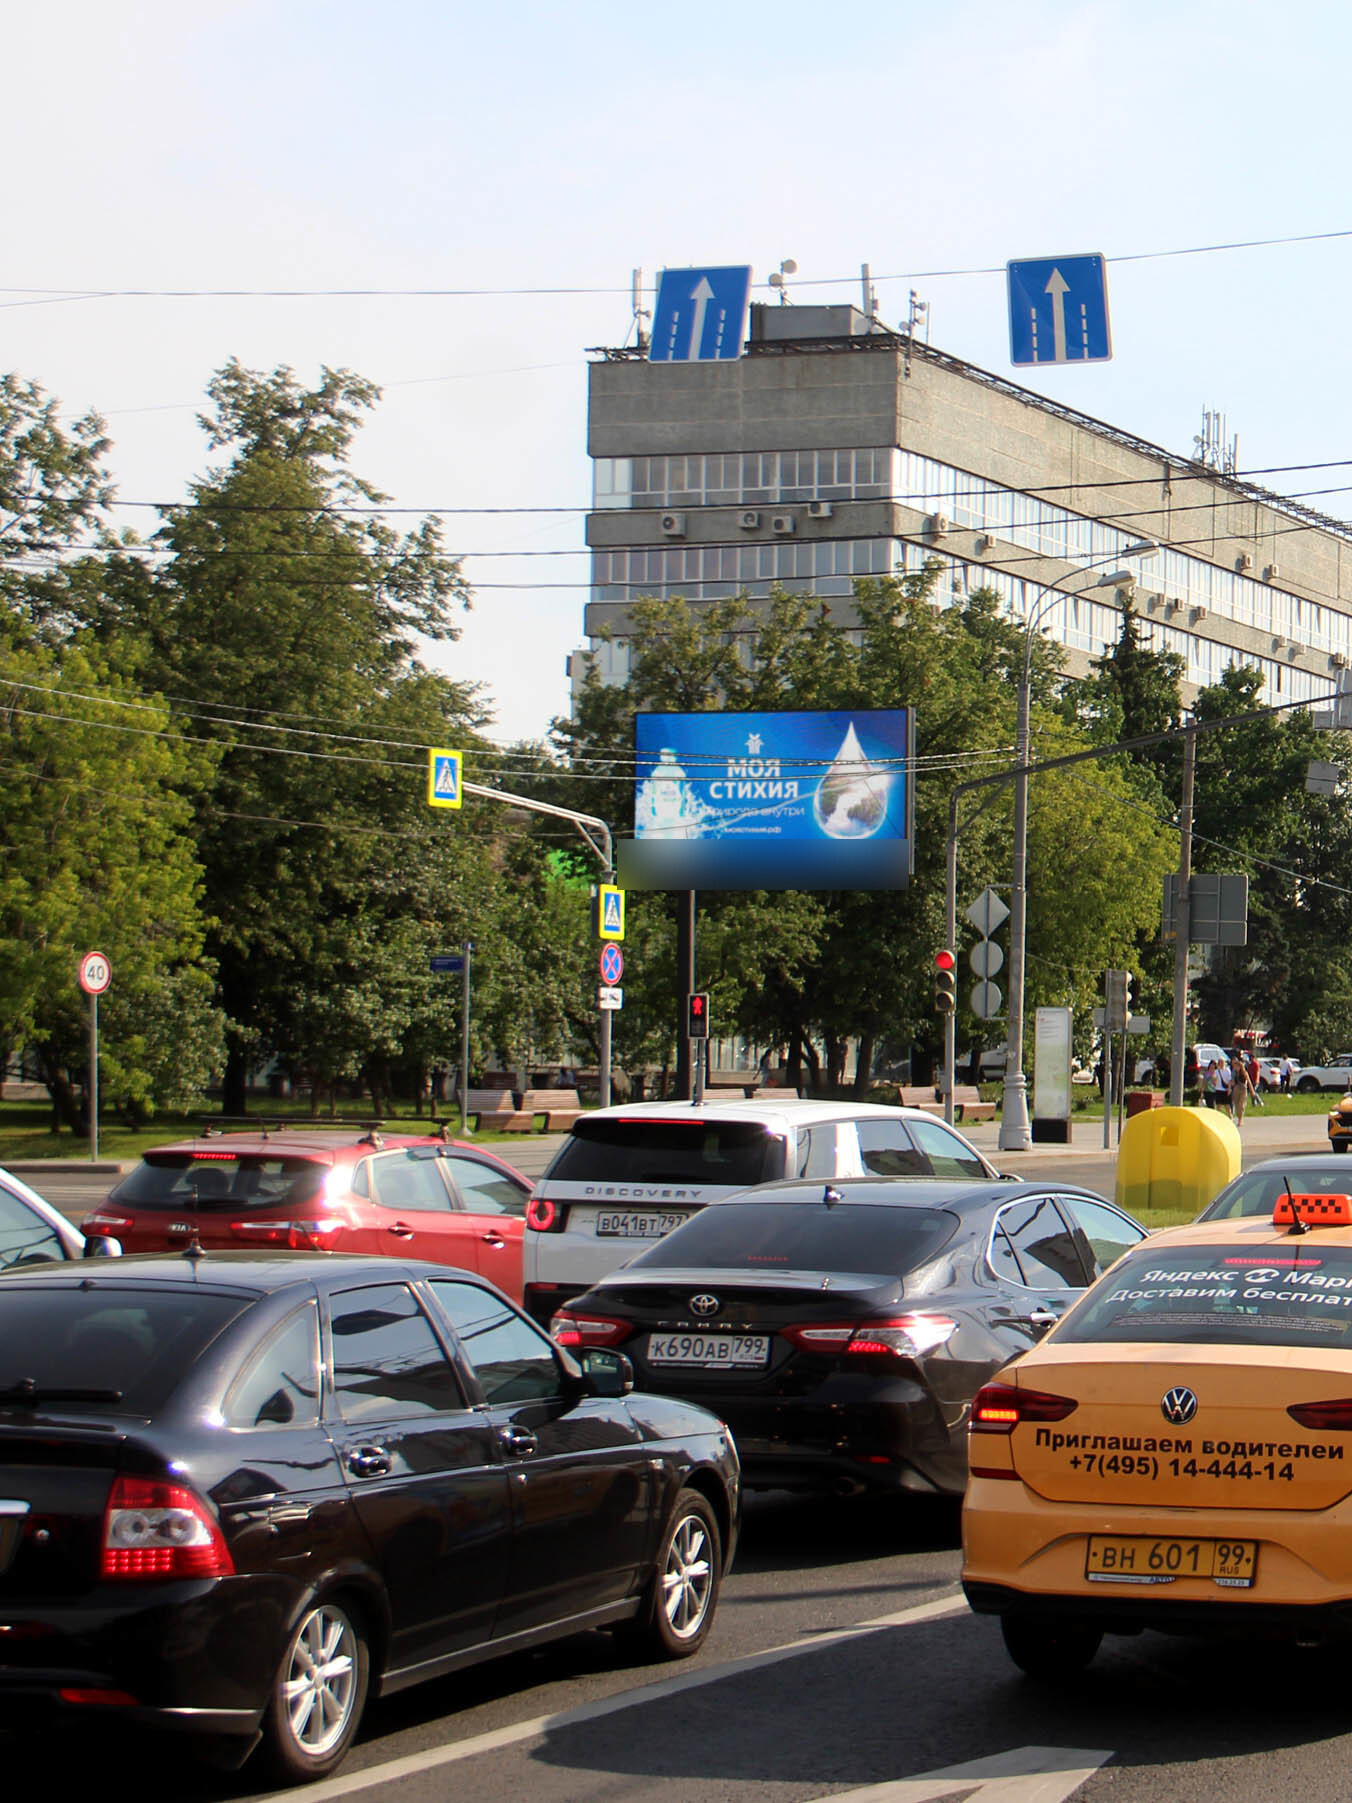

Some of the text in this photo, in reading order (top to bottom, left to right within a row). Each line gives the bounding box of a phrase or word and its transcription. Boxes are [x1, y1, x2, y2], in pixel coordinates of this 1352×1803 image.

[727, 758, 781, 777] МОЯ
[709, 781, 799, 799] СТИХИЯ
[87, 965, 105, 980] 40
[585, 1187, 702, 1197] DISCOVERY
[660, 1215, 683, 1228] 797
[1139, 1269, 1239, 1283] Яндекс
[1105, 1286, 1236, 1303] Доставим
[653, 1336, 764, 1358] К690АВ 799
[1035, 1428, 1193, 1454] Приглашаем
[1070, 1454, 1294, 1481] +7(495) 14-444-14
[1148, 1542, 1200, 1572] 601
[1218, 1544, 1244, 1565] 99
[1219, 1565, 1240, 1575] RUS
